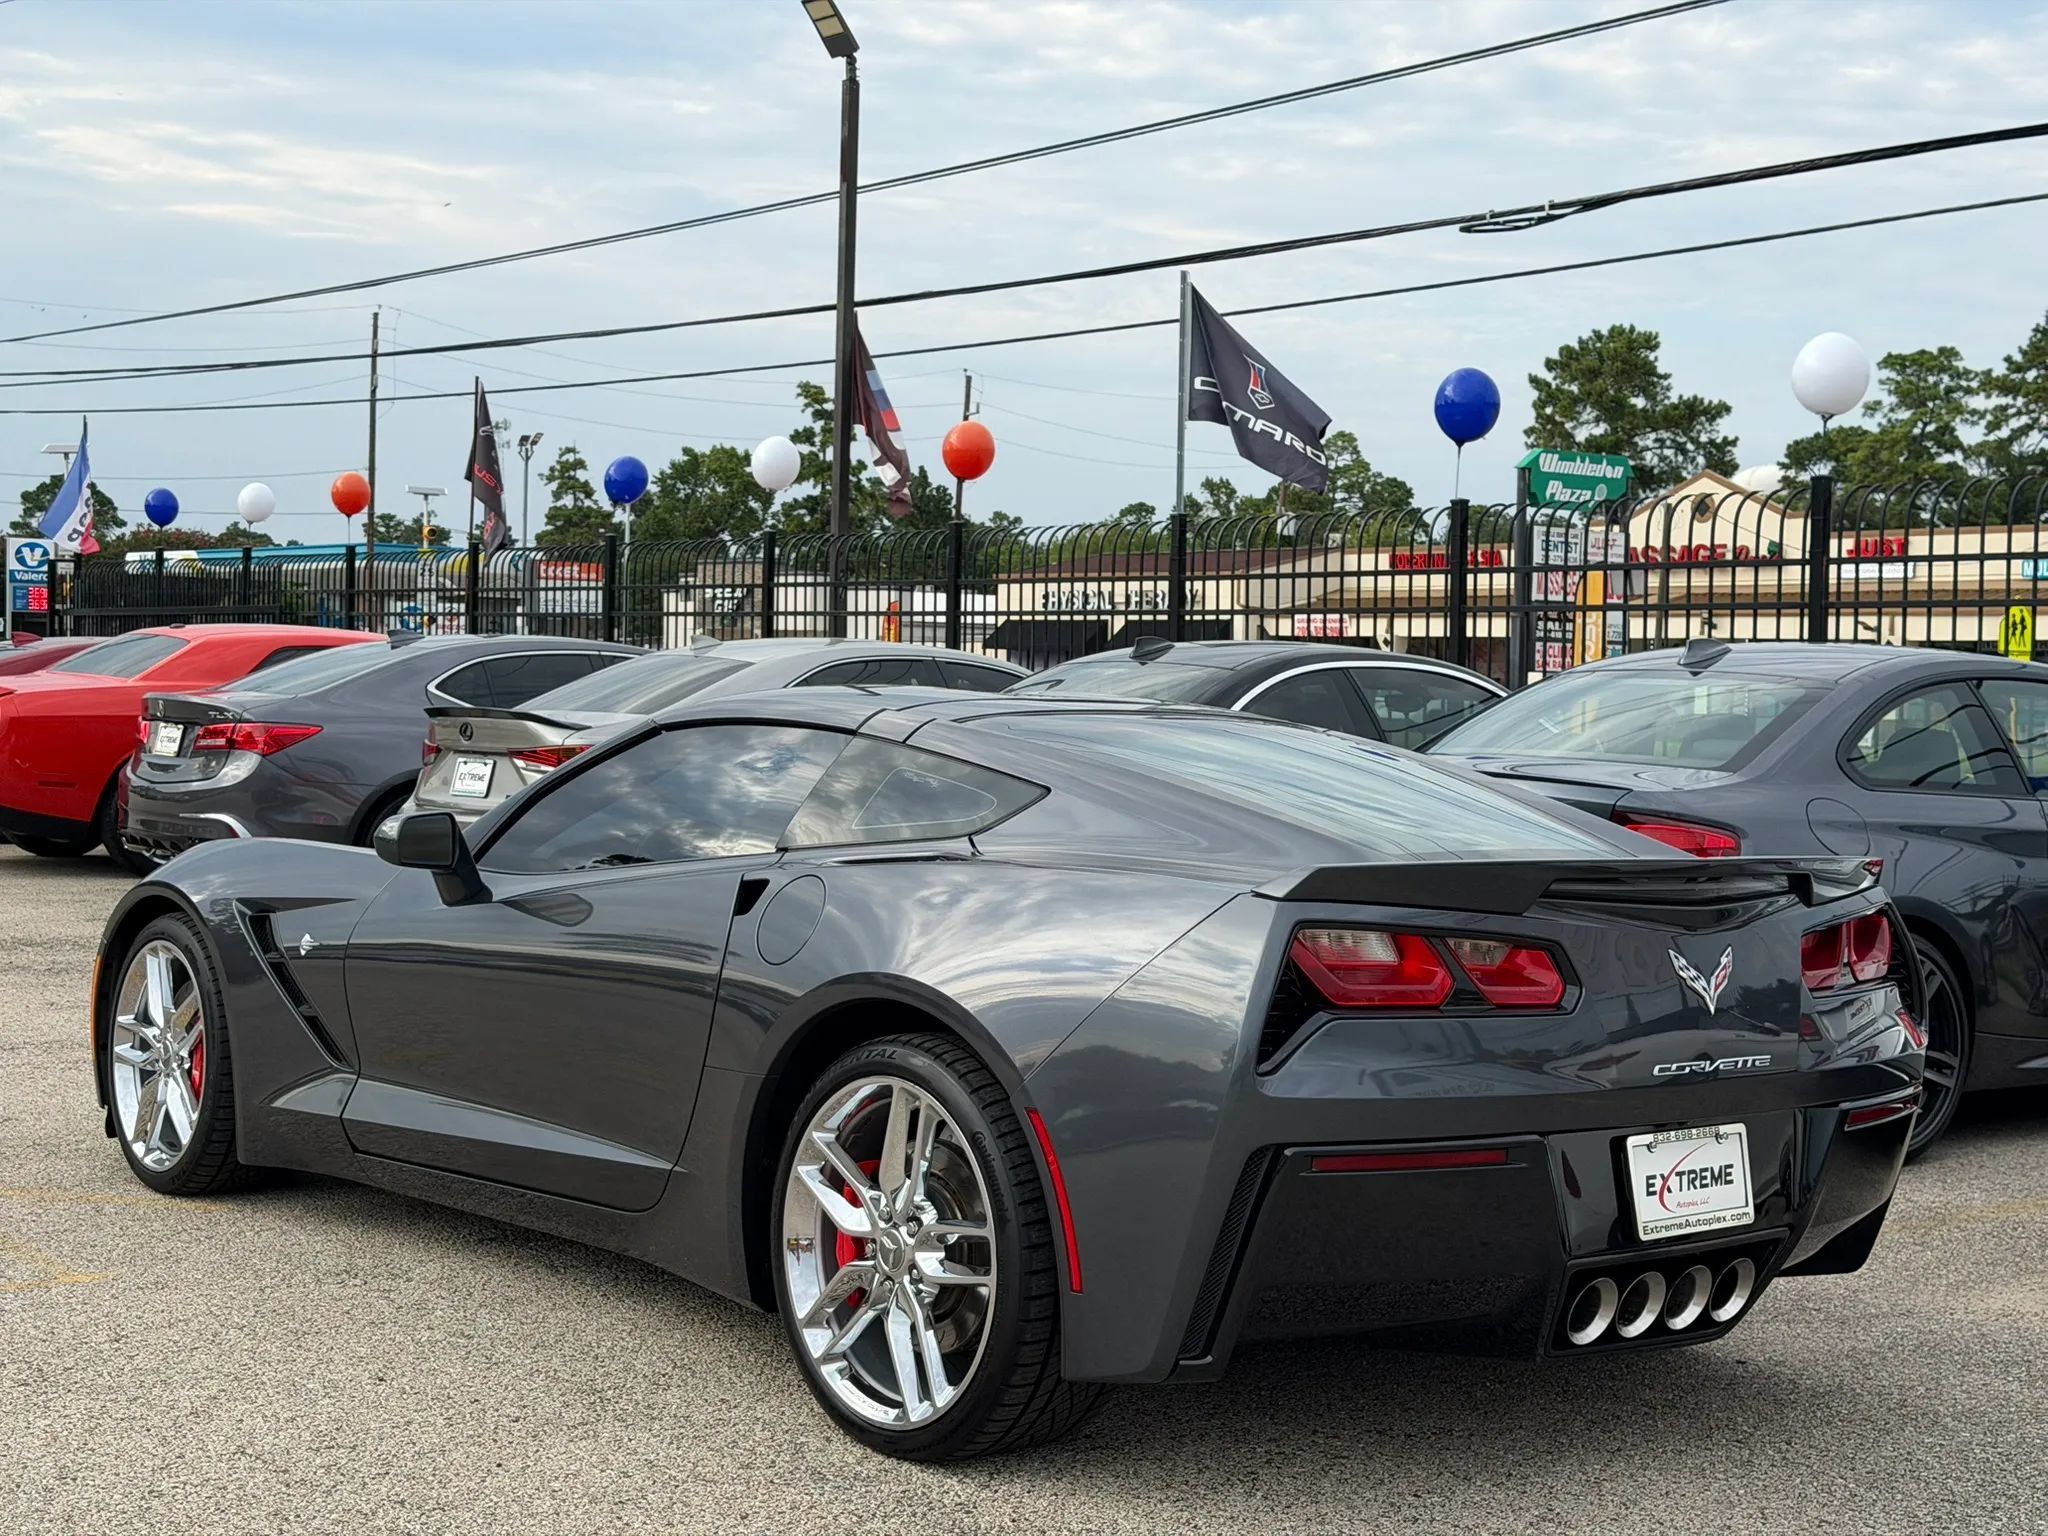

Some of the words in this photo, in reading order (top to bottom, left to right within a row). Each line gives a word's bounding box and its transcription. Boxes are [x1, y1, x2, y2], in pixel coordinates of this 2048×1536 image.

[1194, 376, 1327, 466] CMARO
[1539, 453, 1624, 478] Wimbledon
[1546, 480, 1592, 502] Plaza
[1541, 539, 1579, 554] DENTST
[208, 711, 233, 719] TLX
[1652, 1055, 1771, 1076] CORVETTE
[1646, 1163, 1734, 1197] EXTREME
[1643, 1211, 1750, 1236] ExtremeAutoplex.com
